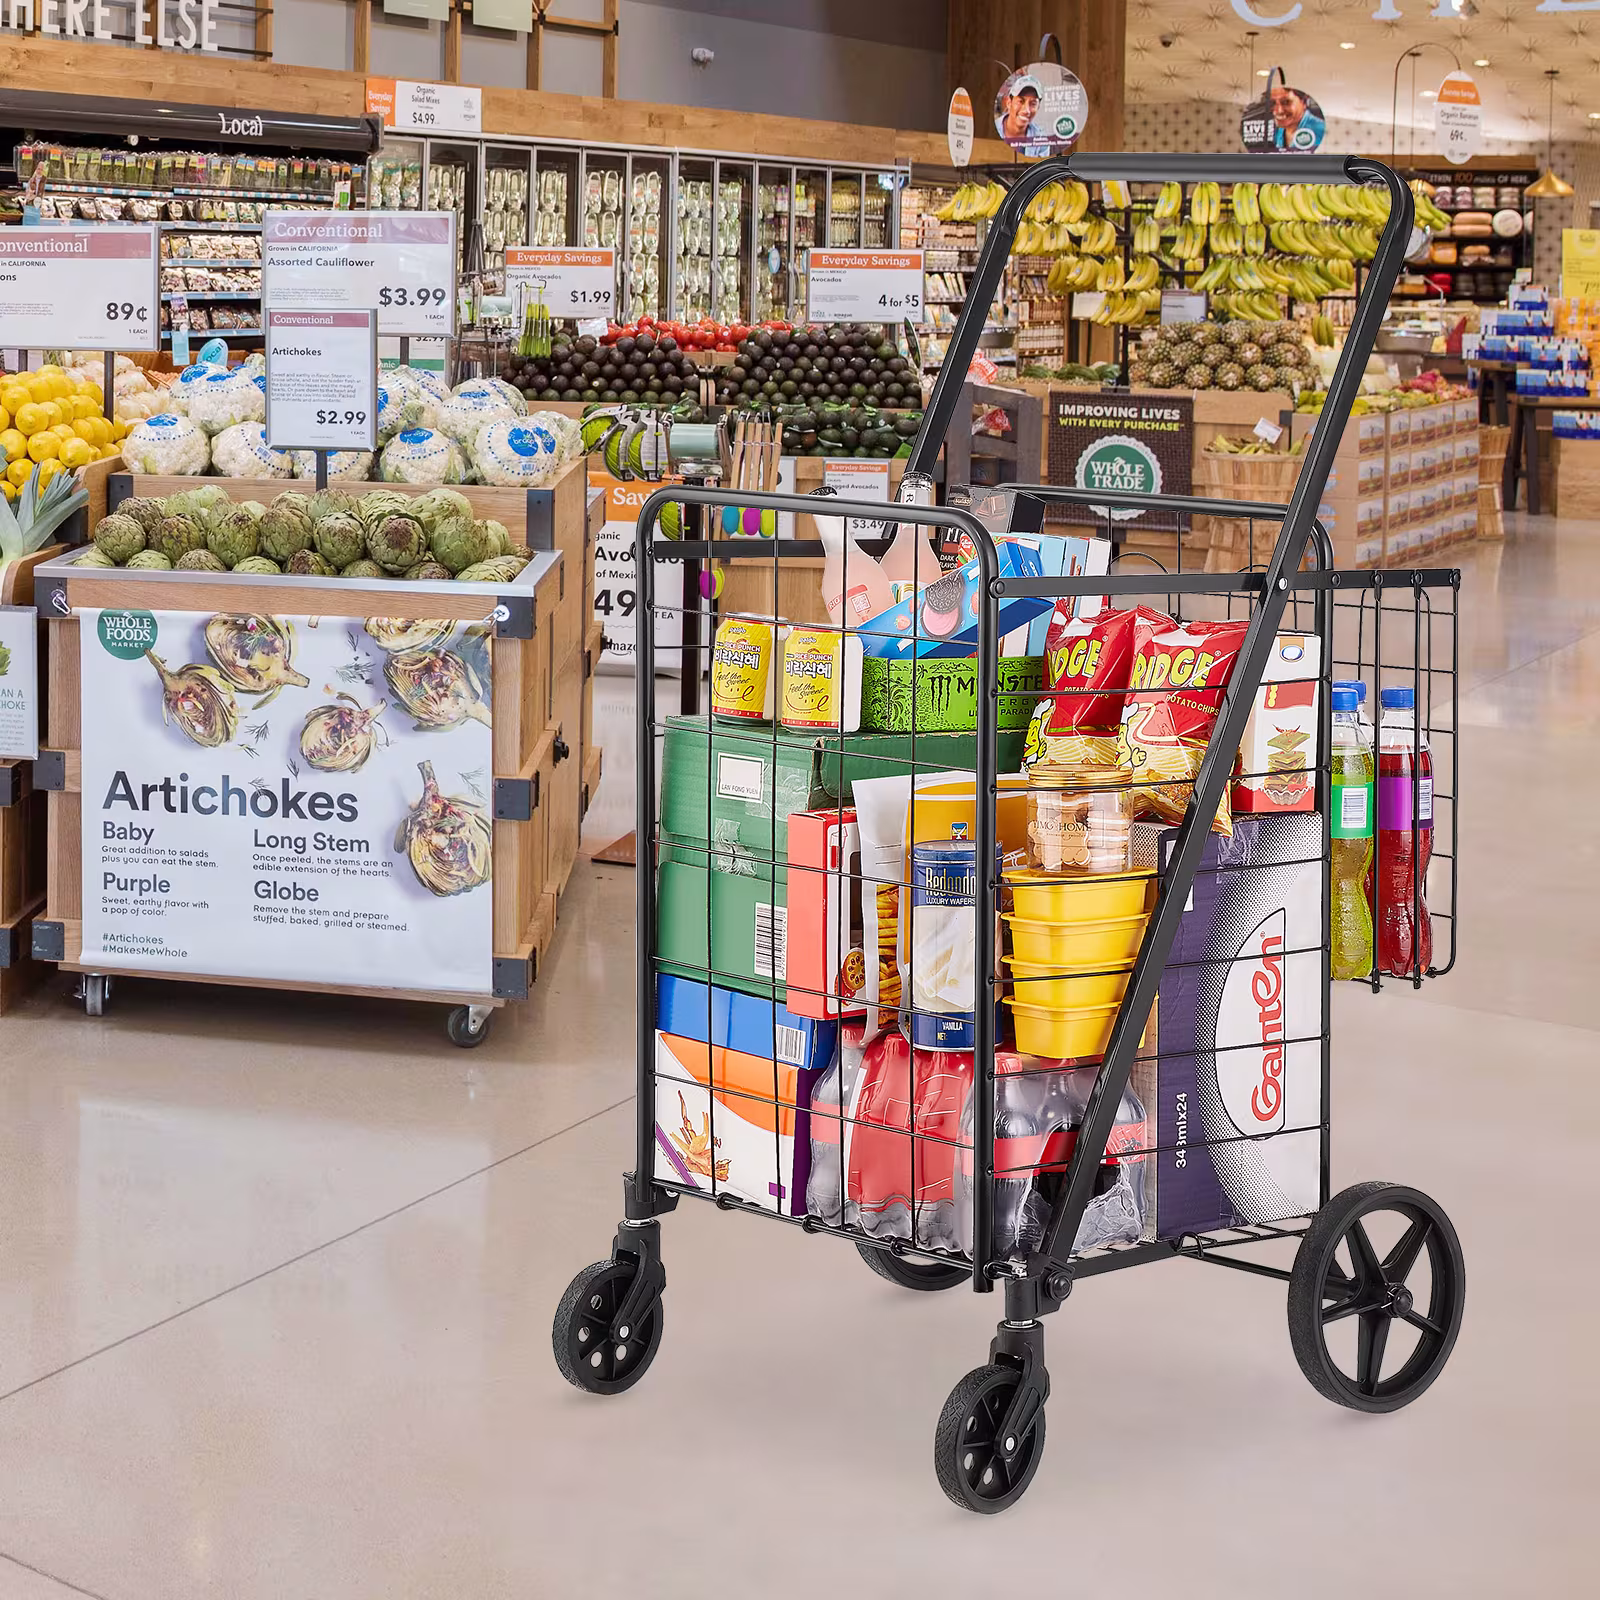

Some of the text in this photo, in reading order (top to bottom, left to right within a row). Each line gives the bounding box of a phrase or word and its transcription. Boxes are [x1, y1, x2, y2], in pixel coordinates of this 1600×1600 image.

[0, 0, 219, 51] HERE ELSE
[416, 85, 436, 95] Organic
[1044, 91, 1080, 101] LIVES
[412, 95, 425, 103] Salad
[218, 112, 263, 137] Local
[412, 112, 435, 124] $4.99
[275, 222, 382, 238] Conventional
[268, 258, 374, 267] Assorted Cauliflower
[518, 252, 602, 264] Everyday Savings
[822, 255, 910, 267] Everyday Savings
[379, 286, 446, 307] $3.99
[571, 290, 611, 303] $1.99
[879, 294, 919, 307] 4 for $5
[106, 302, 147, 322] 89¢
[274, 315, 333, 325] Conventional
[272, 347, 322, 356] Artichokes
[316, 410, 366, 425] $2.99
[1059, 404, 1180, 420] IMPROVING LIVES
[1059, 418, 1180, 432] WITH EVERY PURCHASE
[1090, 459, 1145, 477] WHOLE
[1092, 475, 1145, 490] TRADE
[613, 487, 656, 506] Sav
[853, 519, 884, 529] $3.49
[596, 570, 605, 578] of
[103, 614, 152, 629] WHOLE
[106, 628, 151, 642] FOODS
[738, 644, 761, 652] PUNCH
[715, 649, 760, 670] 비락식혜
[785, 660, 832, 679] 비락식혜
[1131, 648, 1215, 691] RIDGE
[17, 690, 24, 698] A
[0, 702, 25, 710] HOKE
[1166, 694, 1219, 716] POTATO CHIPS
[732, 785, 745, 793] FONG
[102, 771, 358, 822] Artichokes
[103, 821, 155, 845] Baby
[254, 829, 369, 854] Long Stem
[102, 845, 126, 853] Great
[129, 846, 166, 855] addition
[179, 849, 209, 858] salads
[102, 855, 120, 863] plus
[195, 860, 219, 868] stem.
[253, 854, 276, 862] Once
[279, 855, 314, 864] peeled,
[317, 857, 331, 865] the
[334, 858, 360, 866] stems
[284, 865, 328, 874] extension
[331, 867, 340, 876] of
[360, 868, 392, 877] hearts.
[103, 871, 171, 896] Purple
[926, 867, 976, 896] Redondo
[254, 880, 319, 902] Globe
[102, 896, 209, 909] Sweet, earthy flavor with
[110, 907, 128, 915] pop
[130, 907, 140, 916] of
[142, 908, 167, 916] color.
[253, 905, 389, 921] Remove the stem and prepare
[253, 915, 287, 924] stuffed,
[290, 916, 321, 926] baked,
[324, 919, 352, 928] grilled
[367, 922, 410, 932] steamed.
[102, 933, 164, 945] #Artichokes
[102, 944, 188, 958] #MakesMeWhole
[942, 1021, 963, 1030] VANILLA
[1251, 935, 1282, 1122] Ganten
